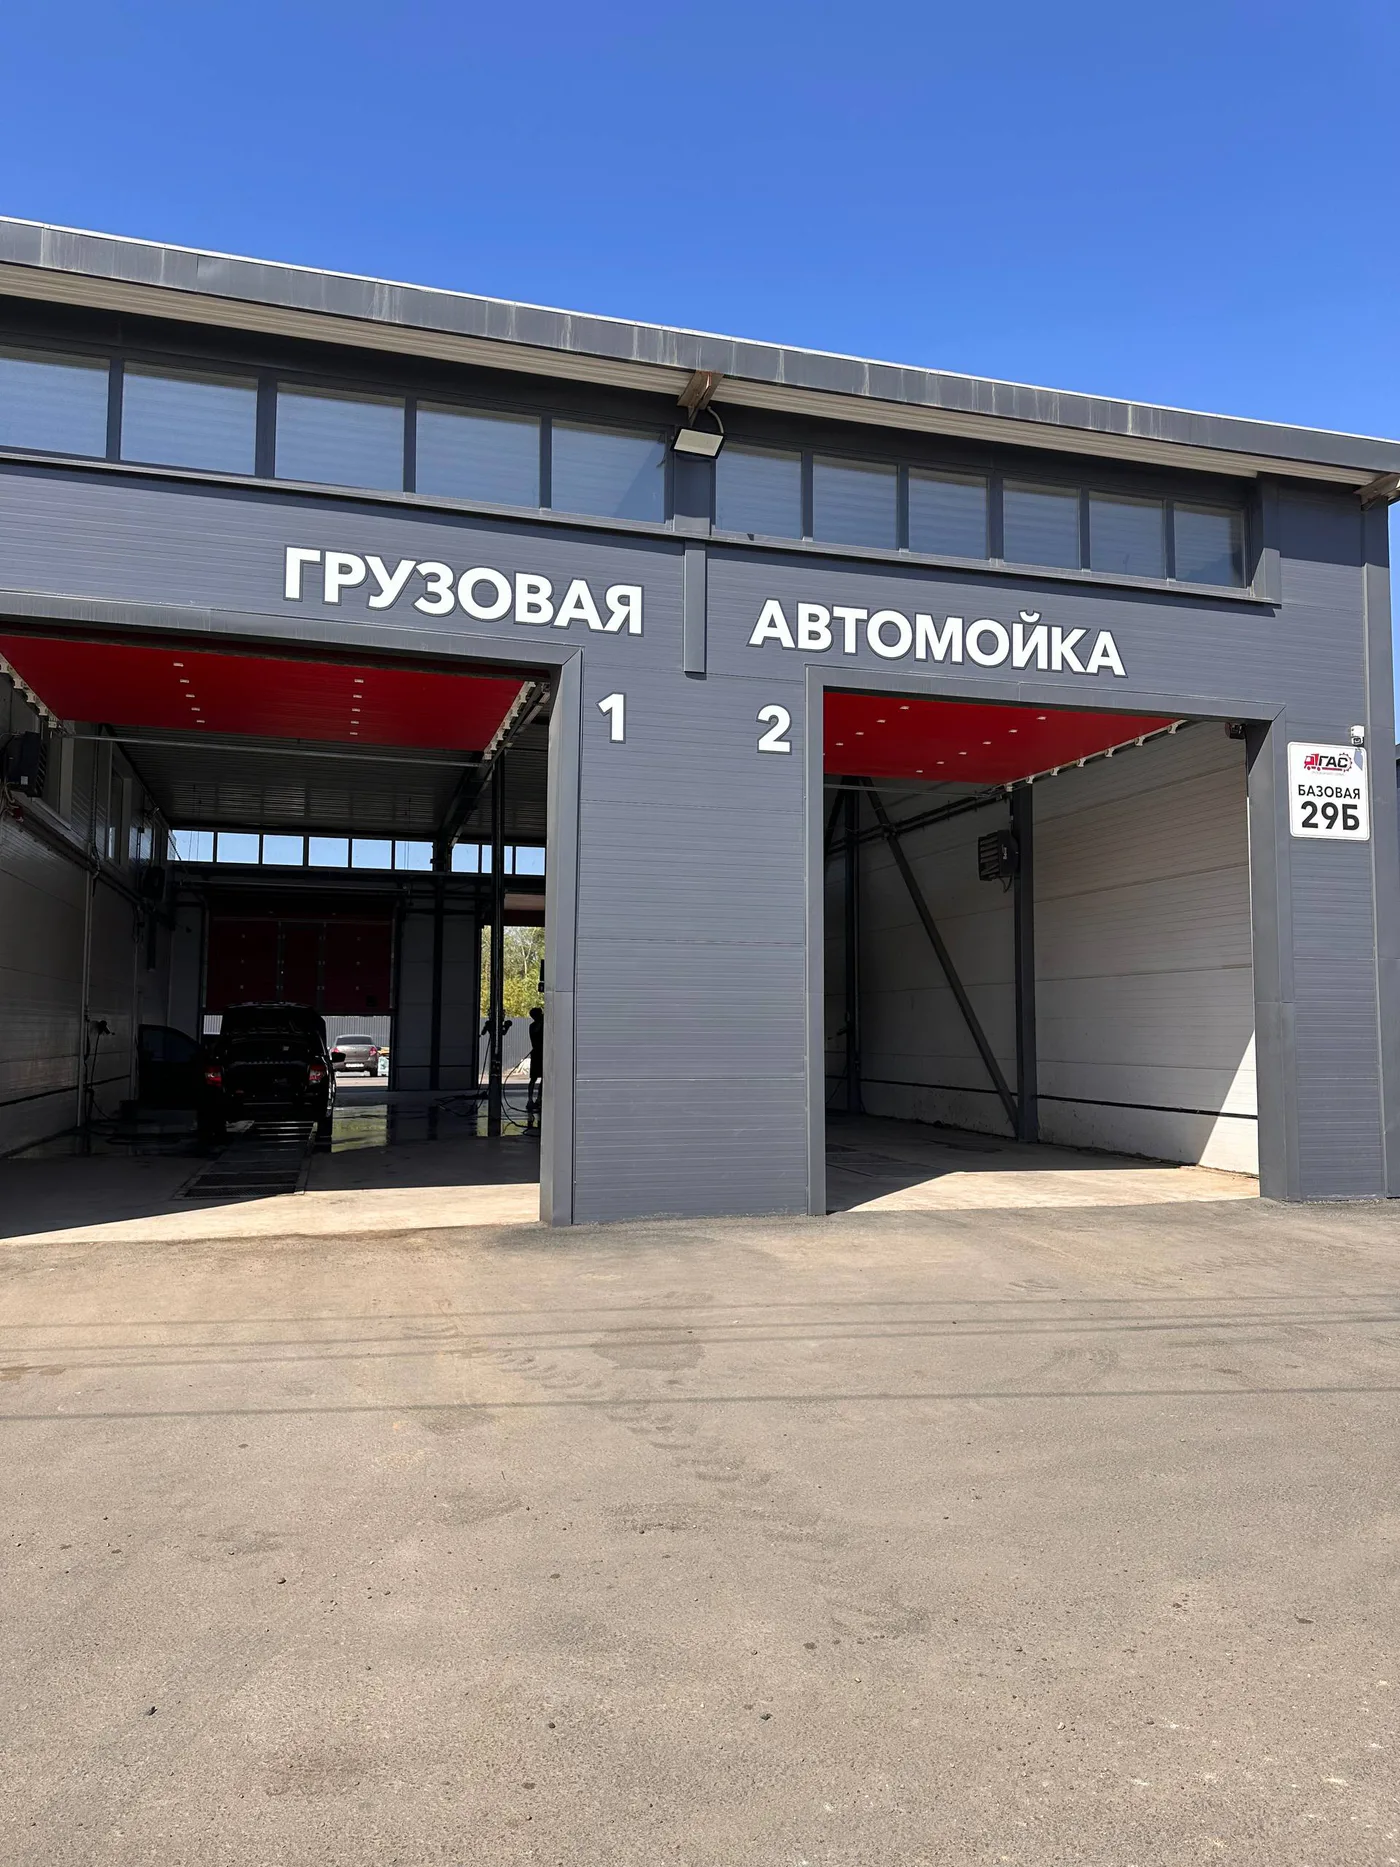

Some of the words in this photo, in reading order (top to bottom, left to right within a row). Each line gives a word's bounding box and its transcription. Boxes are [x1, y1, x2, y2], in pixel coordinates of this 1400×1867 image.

[284, 546, 643, 636] ГРУЗОВАЯ
[747, 598, 1127, 677] АВТОМОЙКА
[598, 693, 626, 743] 1
[756, 704, 792, 754] 2
[1318, 755, 1348, 768] ГАС
[1298, 784, 1360, 799] БАЗОВАЯ
[1301, 801, 1360, 830] 29Б
